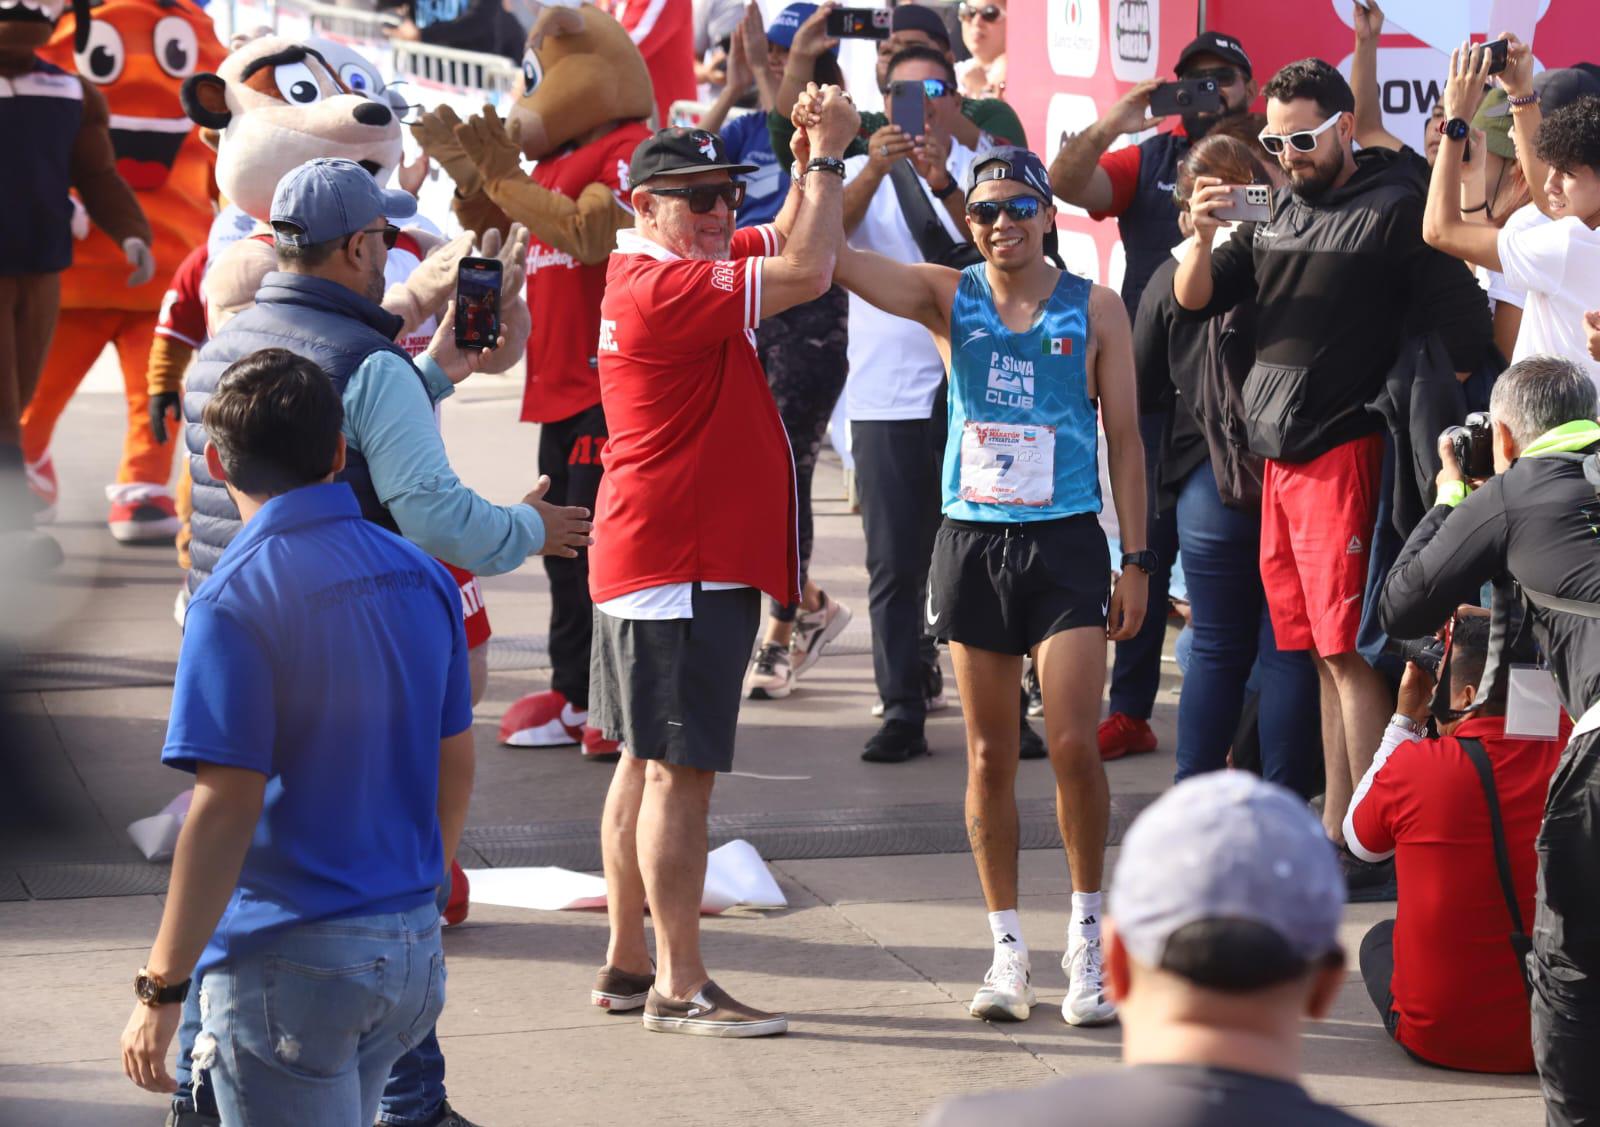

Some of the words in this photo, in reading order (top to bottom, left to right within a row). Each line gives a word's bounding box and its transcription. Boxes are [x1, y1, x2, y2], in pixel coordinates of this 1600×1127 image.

[1378, 79, 1447, 114] OW
[990, 352, 999, 368] P.
[1002, 356, 1035, 376] SILVA
[985, 390, 1034, 410] CLUB
[996, 454, 1014, 476] 7
